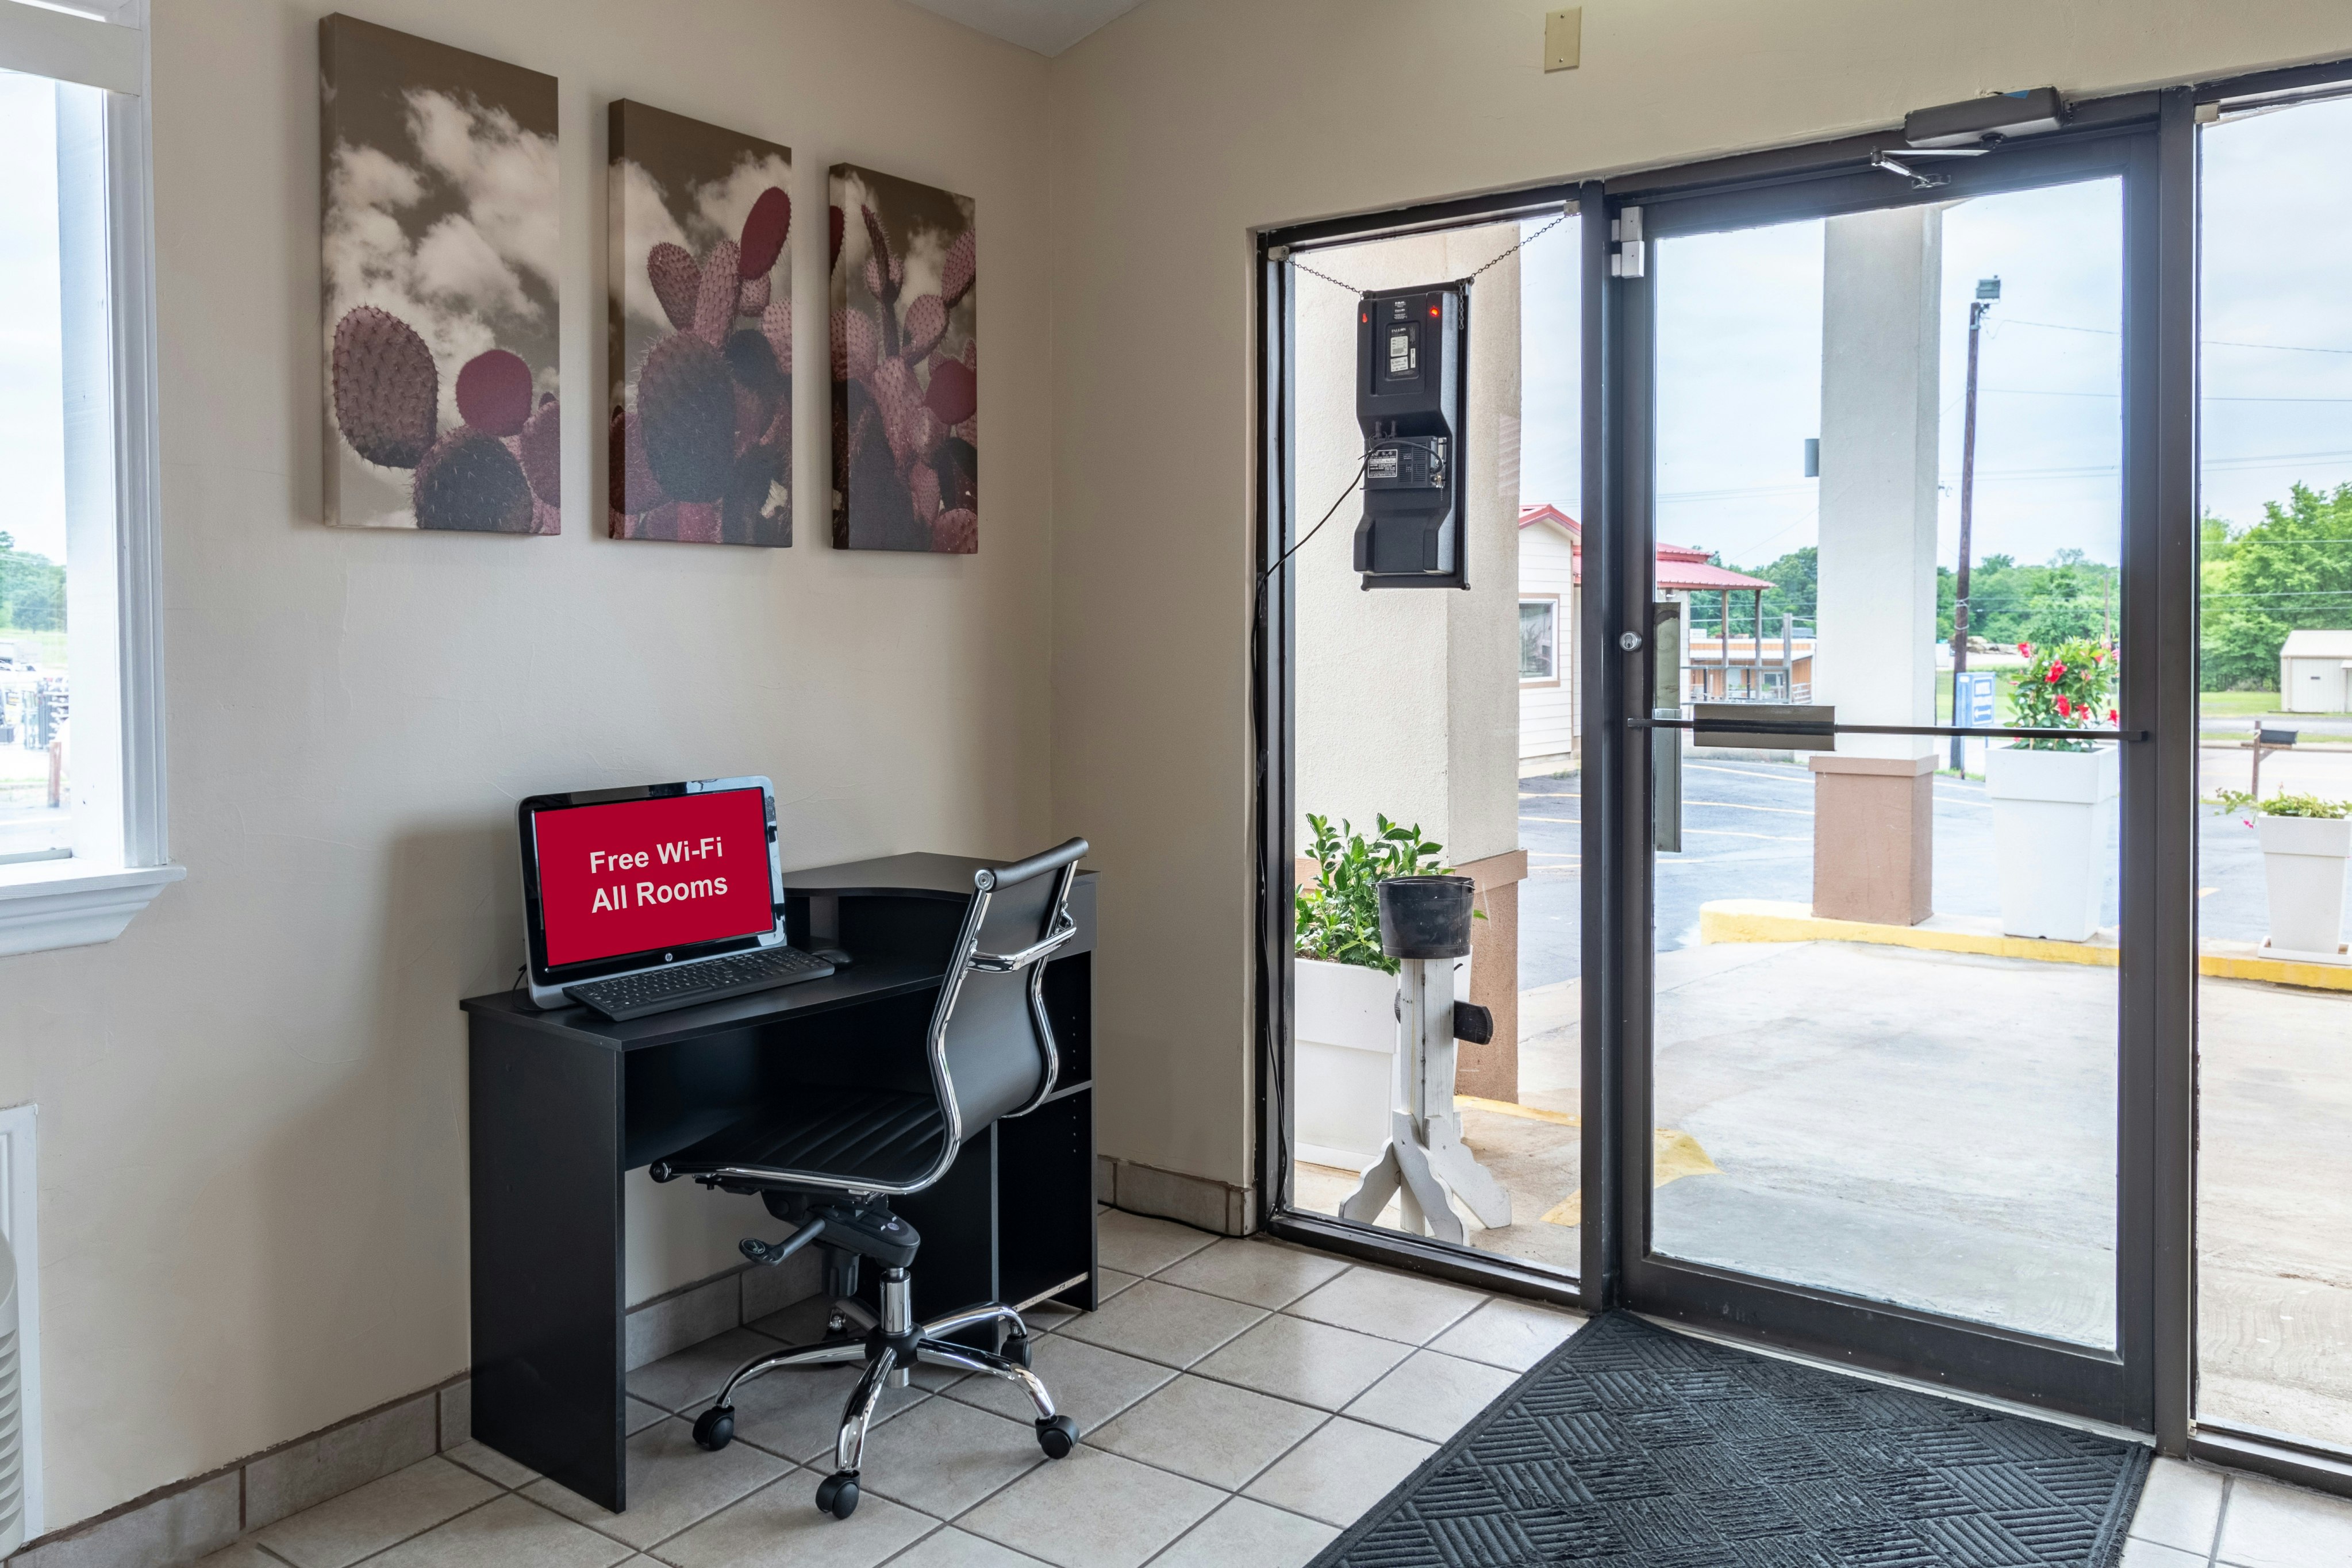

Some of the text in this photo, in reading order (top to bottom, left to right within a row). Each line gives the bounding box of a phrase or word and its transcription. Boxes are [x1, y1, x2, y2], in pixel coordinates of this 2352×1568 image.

[590, 837, 722, 874] Free Wi-Fi
[591, 877, 728, 913] All Rooms
